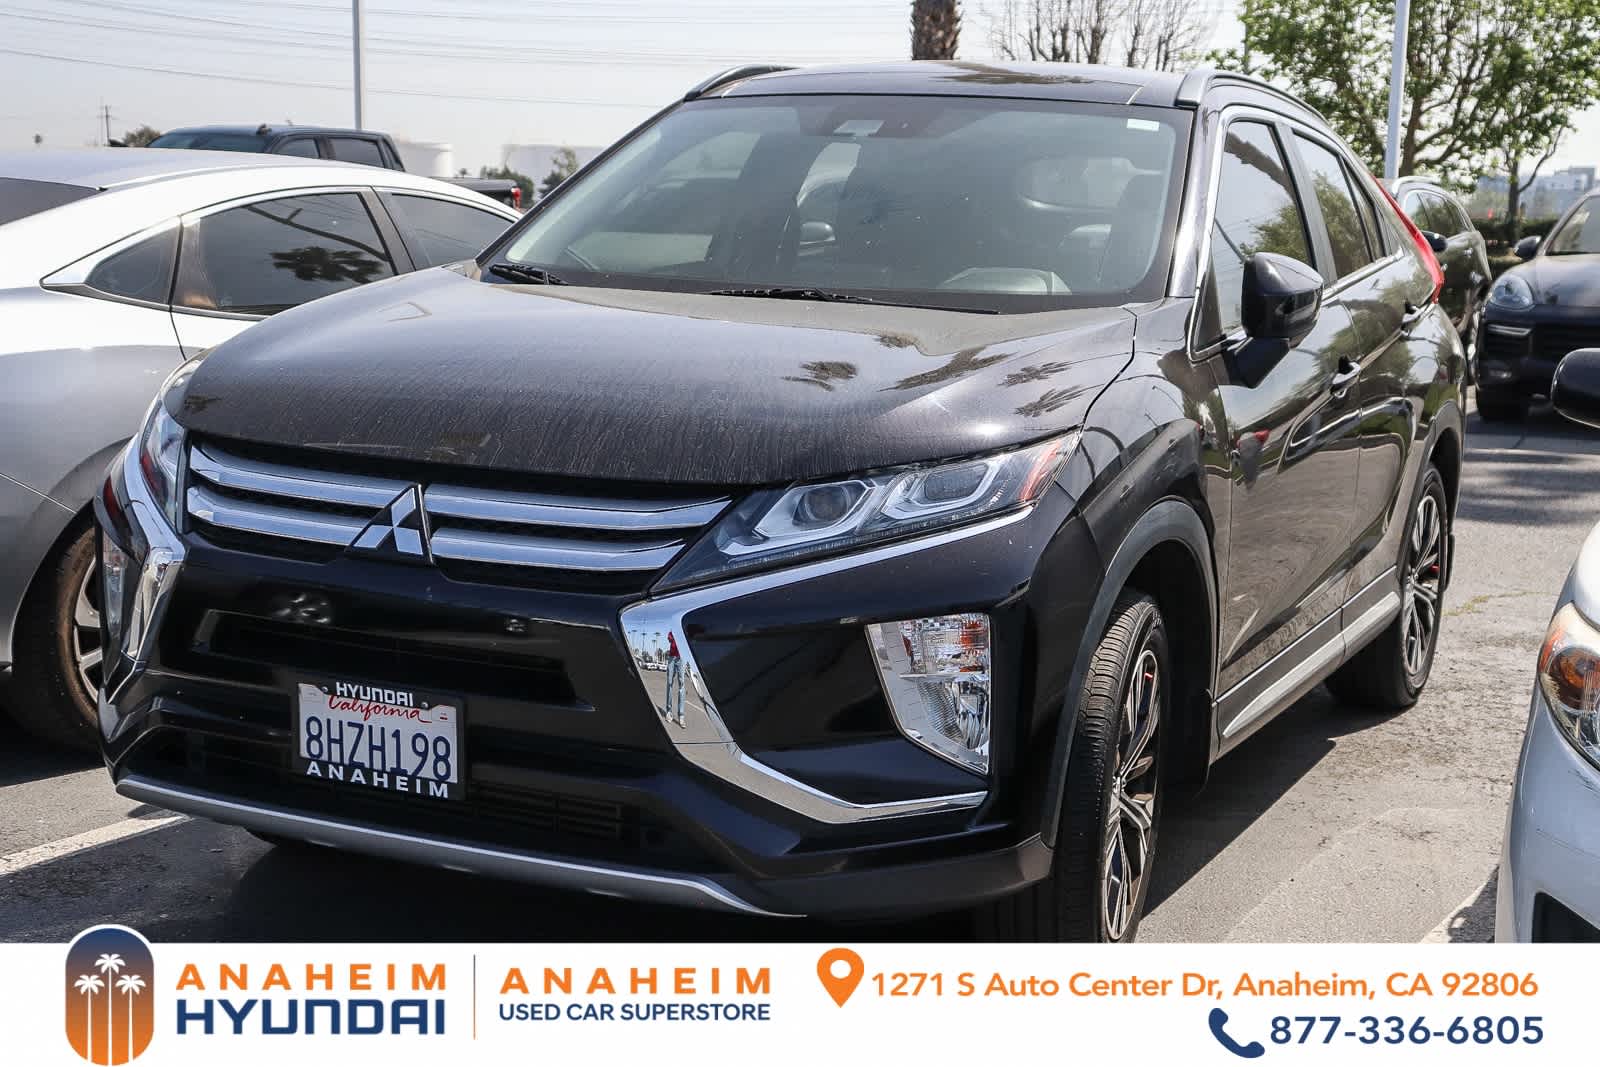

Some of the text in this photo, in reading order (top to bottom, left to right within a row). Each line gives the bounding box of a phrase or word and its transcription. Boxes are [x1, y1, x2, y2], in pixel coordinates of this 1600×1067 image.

[328, 694, 433, 724] California
[336, 682, 414, 707] HYUNDAI
[306, 716, 451, 782] 8HZH198
[306, 761, 449, 798] ANAHEIM
